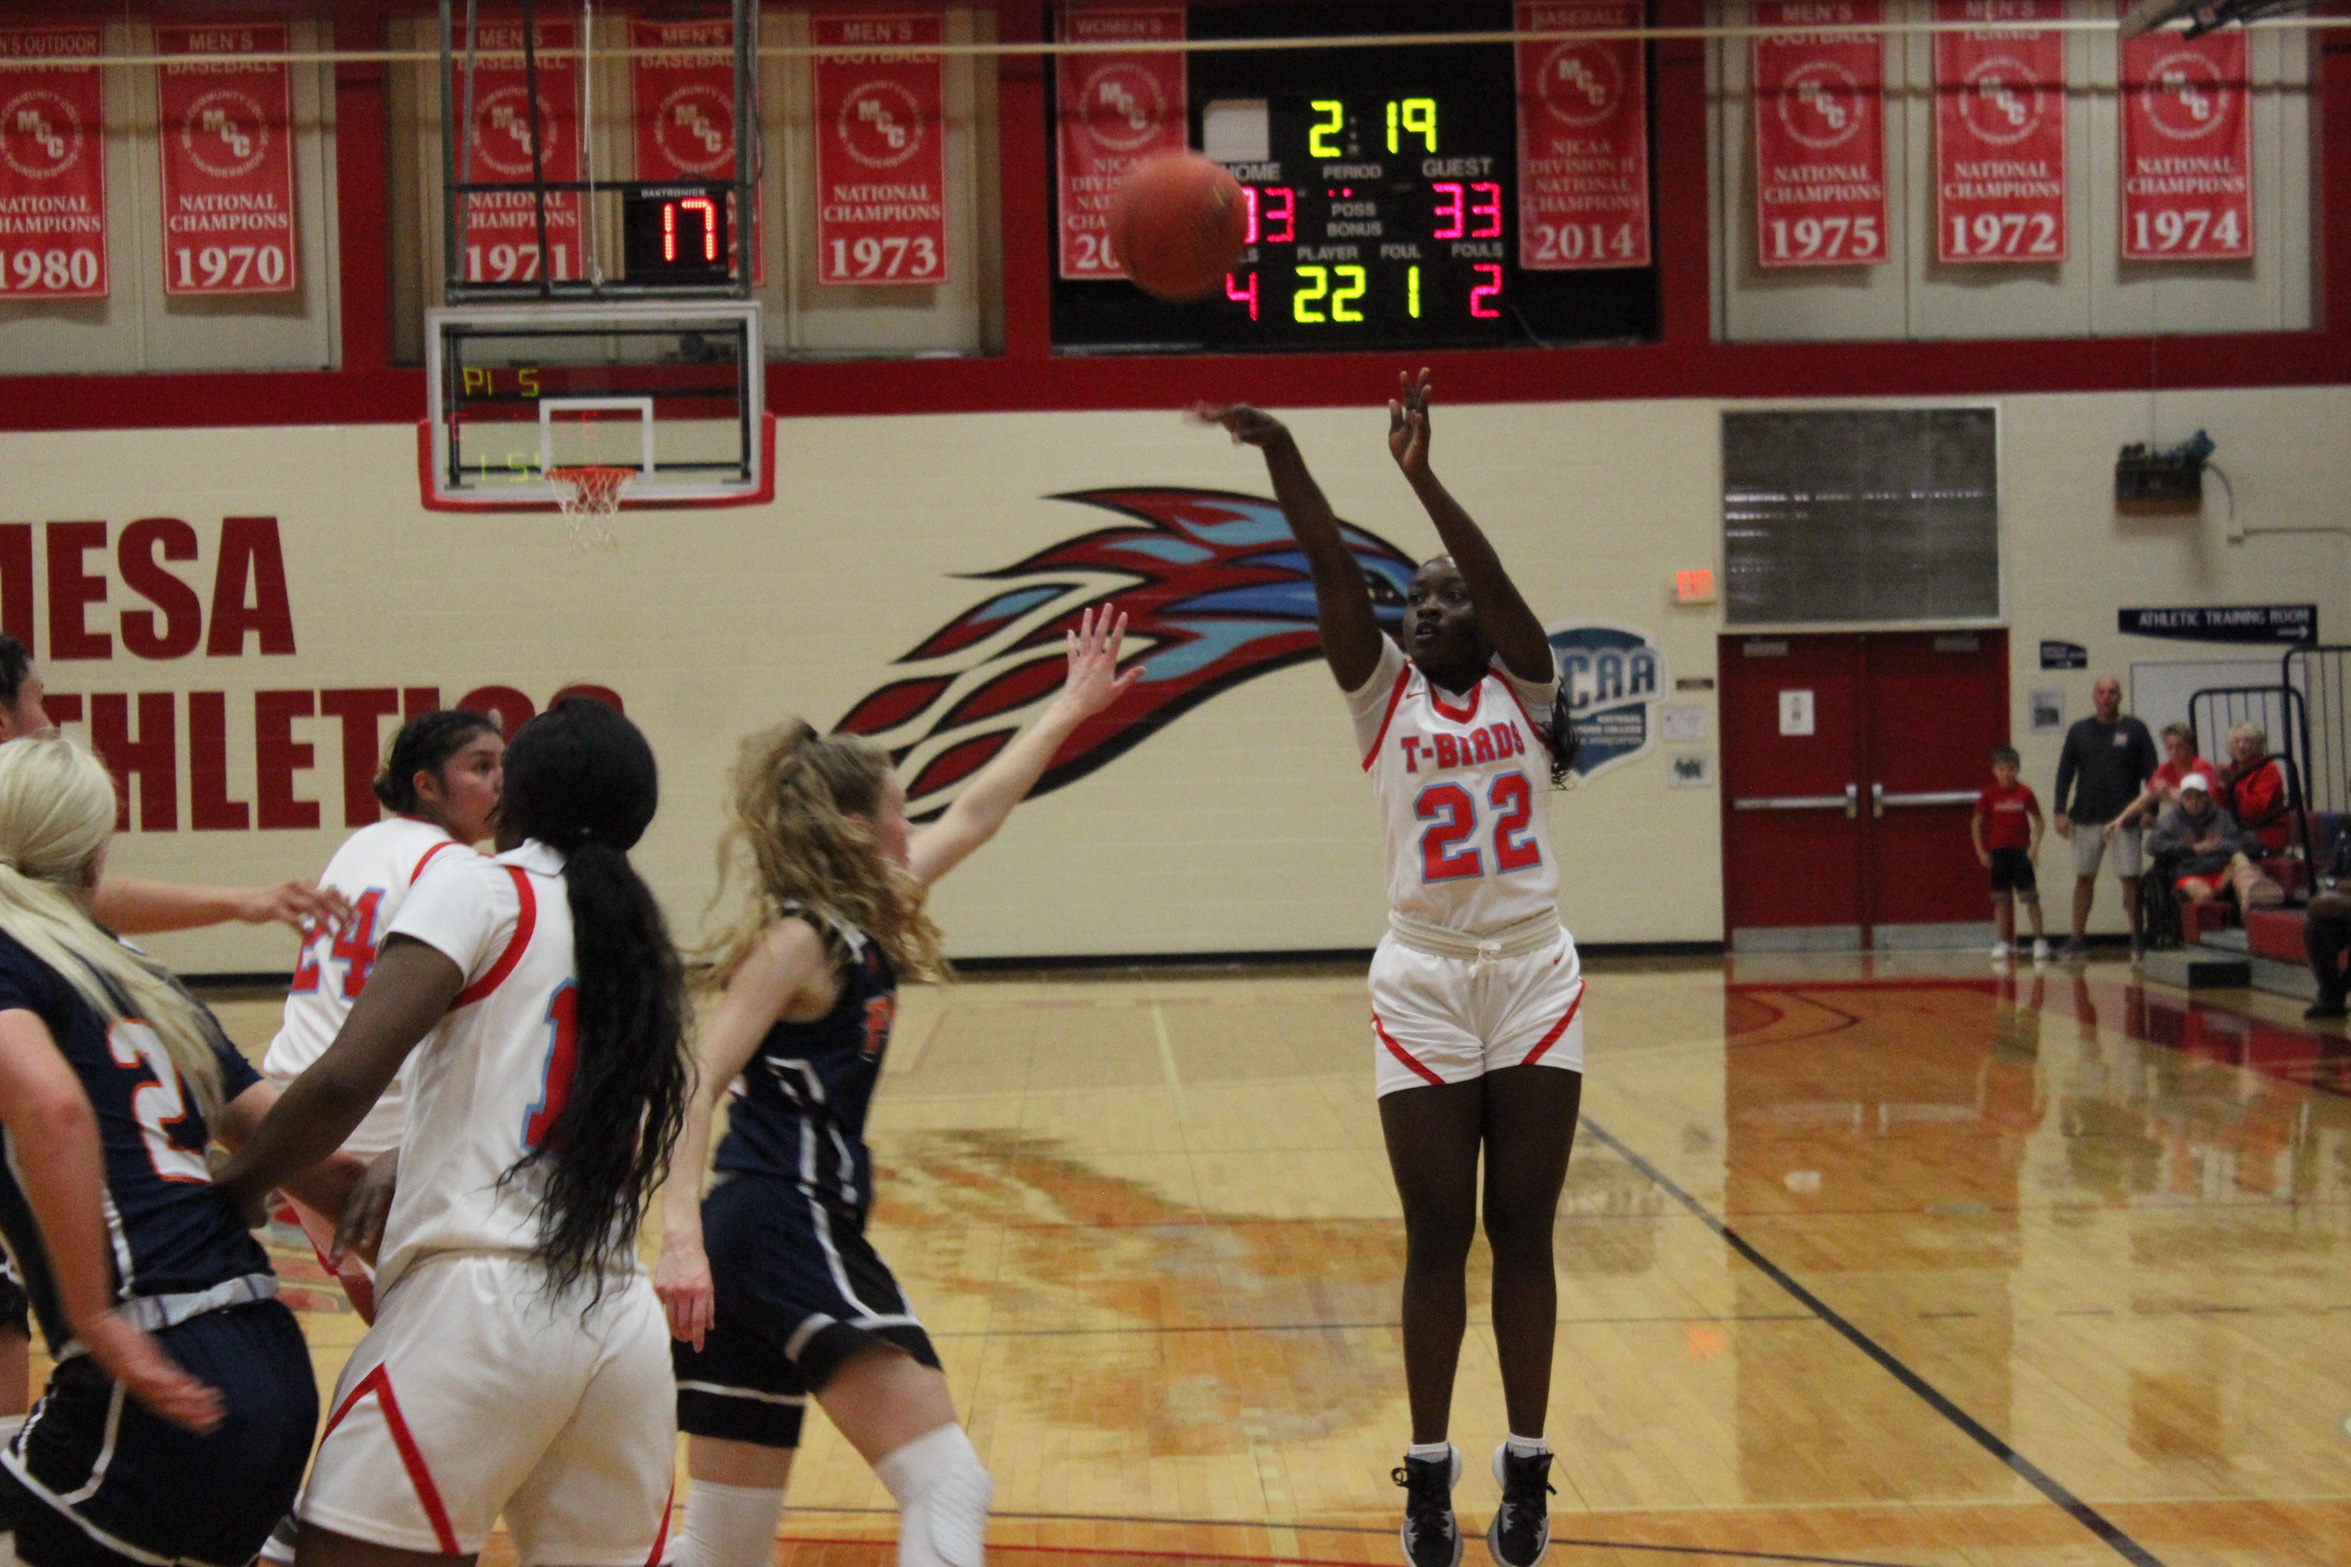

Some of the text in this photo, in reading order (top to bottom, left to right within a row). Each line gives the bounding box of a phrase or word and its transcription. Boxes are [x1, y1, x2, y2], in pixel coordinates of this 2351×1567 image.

[189, 32, 254, 51] MEN'S
[661, 26, 725, 44] MEN'S
[843, 22, 913, 42] MEN'S
[1322, 163, 1384, 180] PERIOD
[1421, 157, 1495, 179] GUEST
[1774, 164, 1870, 183] NATIONAL
[1954, 160, 2050, 180] NATIONAL
[2136, 156, 2233, 175] NATIONAL
[833, 183, 931, 203] NATIONAL
[1535, 176, 1631, 193] NATIONAL
[1763, 184, 1882, 203] CHAMPIONS
[1943, 181, 2062, 199] CHAMPIONS
[2127, 176, 2246, 195] CHAMPIONS
[179, 193, 278, 212] NATIONAL
[823, 203, 941, 222] CHAMPIONS
[1330, 202, 1377, 218] POSS
[1431, 181, 1502, 240] 33
[169, 212, 288, 233] CHAMPIONS
[664, 197, 716, 261] 17
[1326, 221, 1384, 238] BONUS
[2134, 208, 2241, 251] 1974
[1534, 223, 1635, 260] 2014
[1771, 216, 1880, 258] 1975
[1950, 211, 2057, 255] 1972
[831, 236, 937, 277] 1973
[1296, 242, 1504, 261] PLAYER FOUL FOULS
[175, 244, 285, 288] 1970
[464, 243, 570, 282] 1971
[1225, 270, 1259, 322] 4
[1292, 264, 1367, 323] 22
[1469, 262, 1503, 318] 2
[2138, 607, 2310, 627] ATHLETIC TRAINING ROOM
[1401, 719, 1526, 774] T-BIRDS
[1412, 769, 1543, 885] 22
